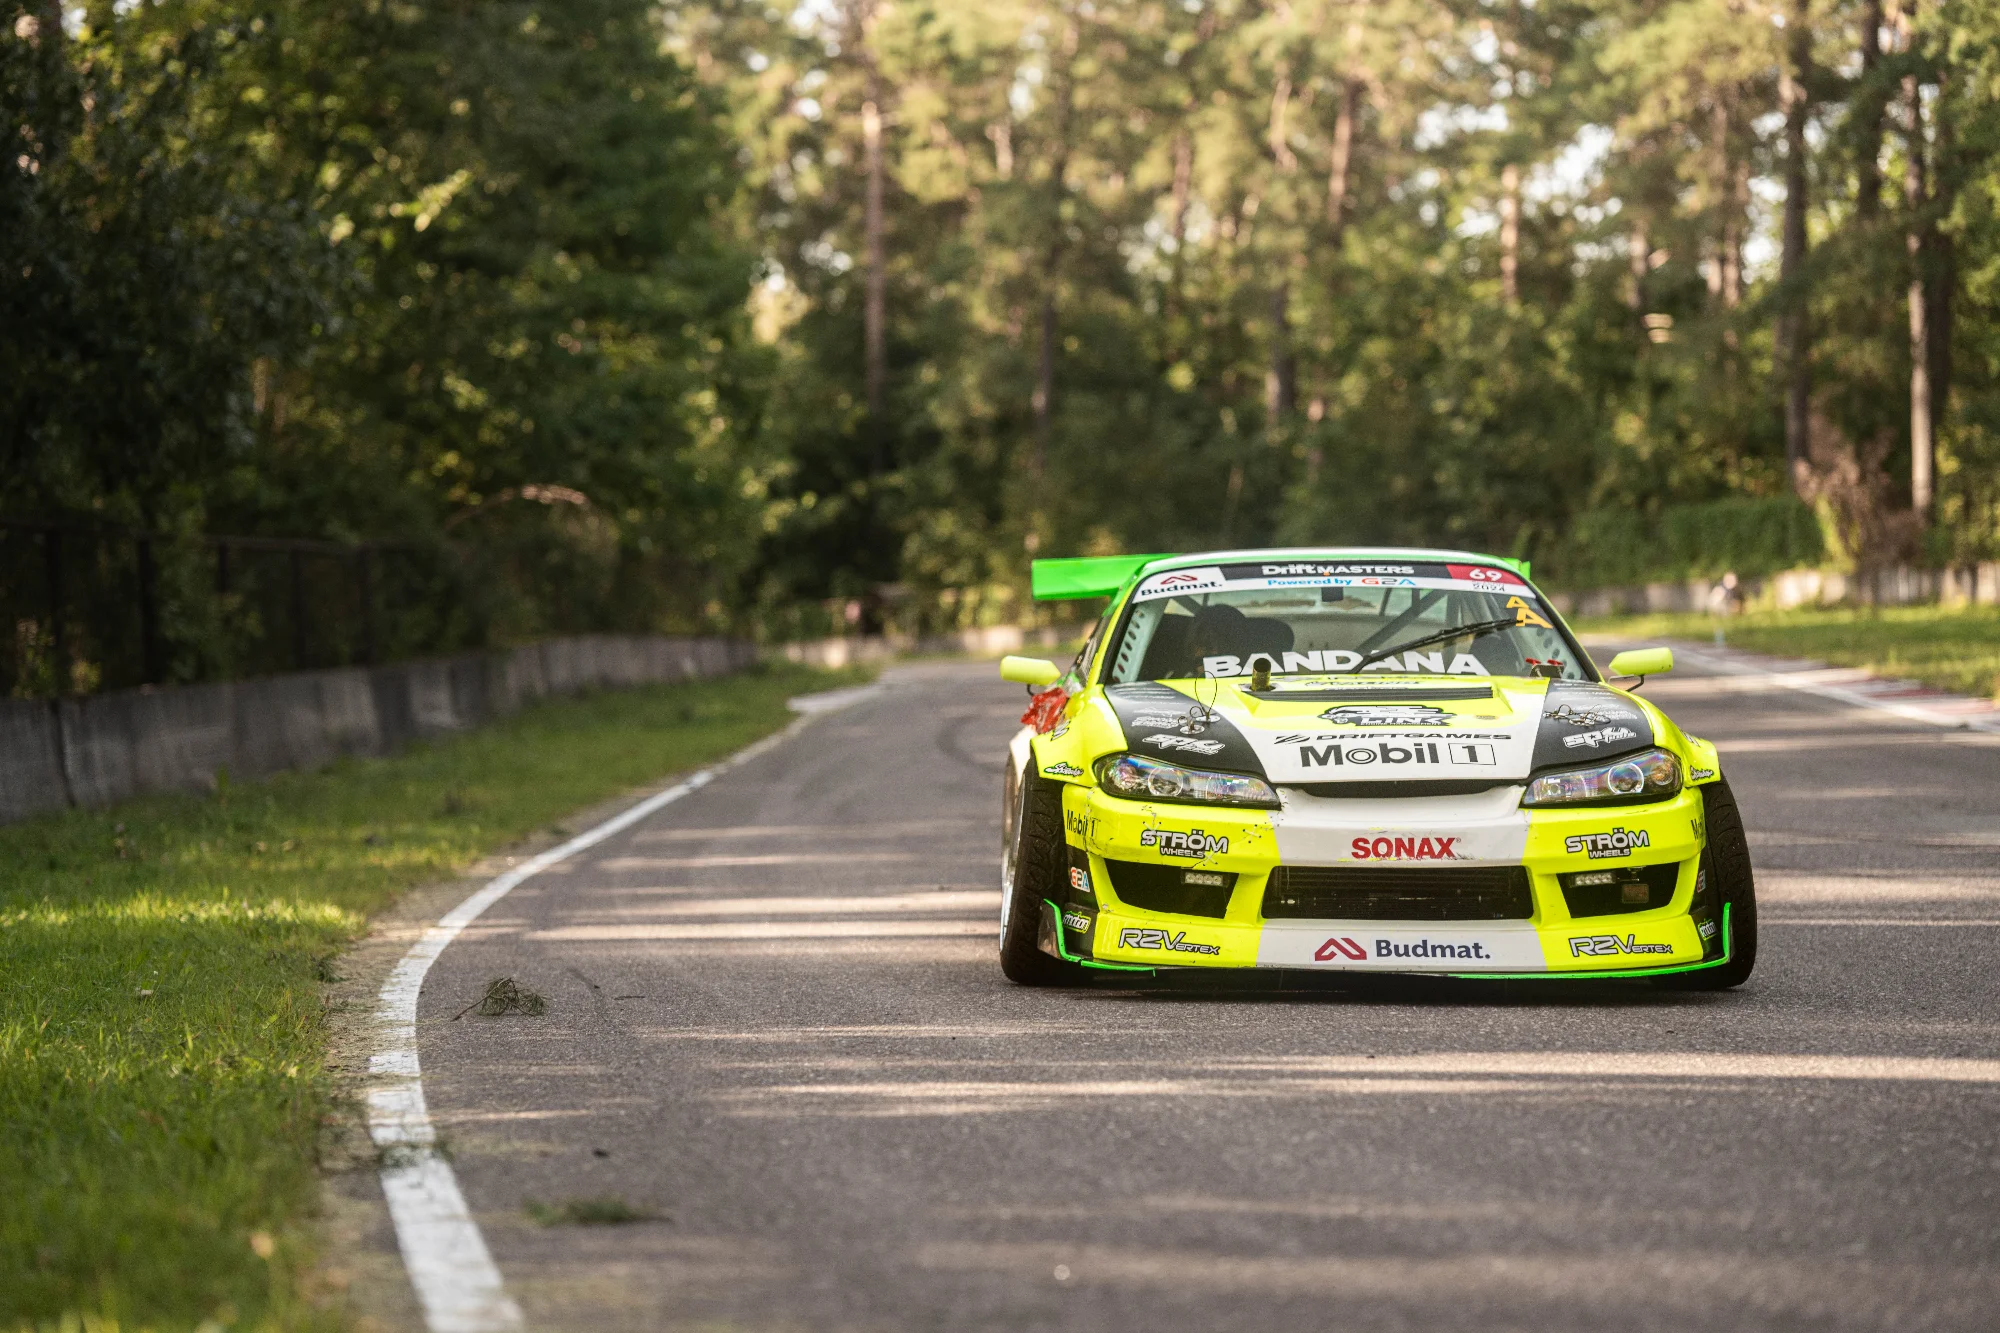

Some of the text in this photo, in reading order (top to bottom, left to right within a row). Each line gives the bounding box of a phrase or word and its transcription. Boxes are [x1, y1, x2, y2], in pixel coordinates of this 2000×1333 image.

[1267, 577, 1416, 586] Powered by G2A
[1469, 568, 1502, 581] 69
[1472, 582, 1505, 591] 2024
[1203, 650, 1491, 679] BANDANA
[1299, 743, 1440, 768] Mobil
[1066, 809, 1088, 837] Mobil
[1141, 830, 1228, 853] STRÖM
[1565, 828, 1650, 853] STRÖM
[1160, 848, 1206, 859] WHEELS
[1589, 848, 1631, 859] WHEELS
[1071, 867, 1090, 892] G2A
[1375, 939, 1491, 959] Budmat.
